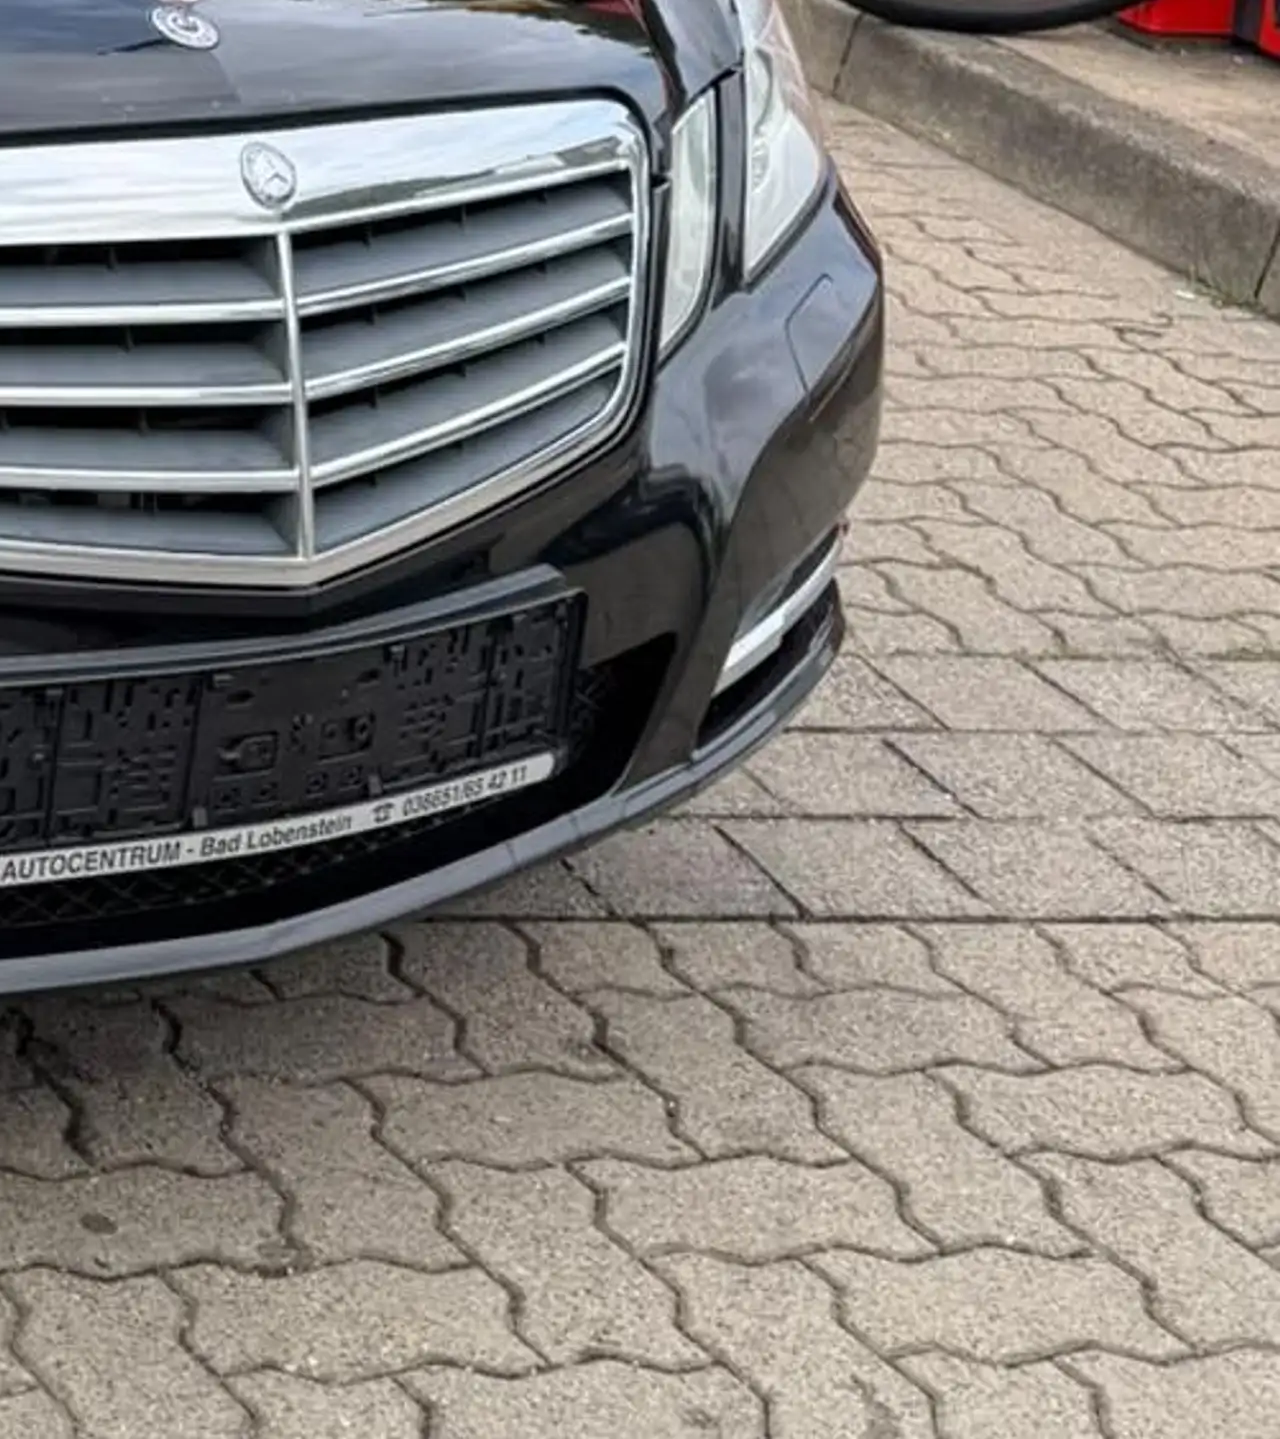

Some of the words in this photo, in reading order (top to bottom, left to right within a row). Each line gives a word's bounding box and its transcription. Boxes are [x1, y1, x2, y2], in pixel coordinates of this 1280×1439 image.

[1, 840, 181, 882] AUTOCENTRUM
[199, 834, 240, 858] Bad
[246, 815, 353, 851] Lobenstein
